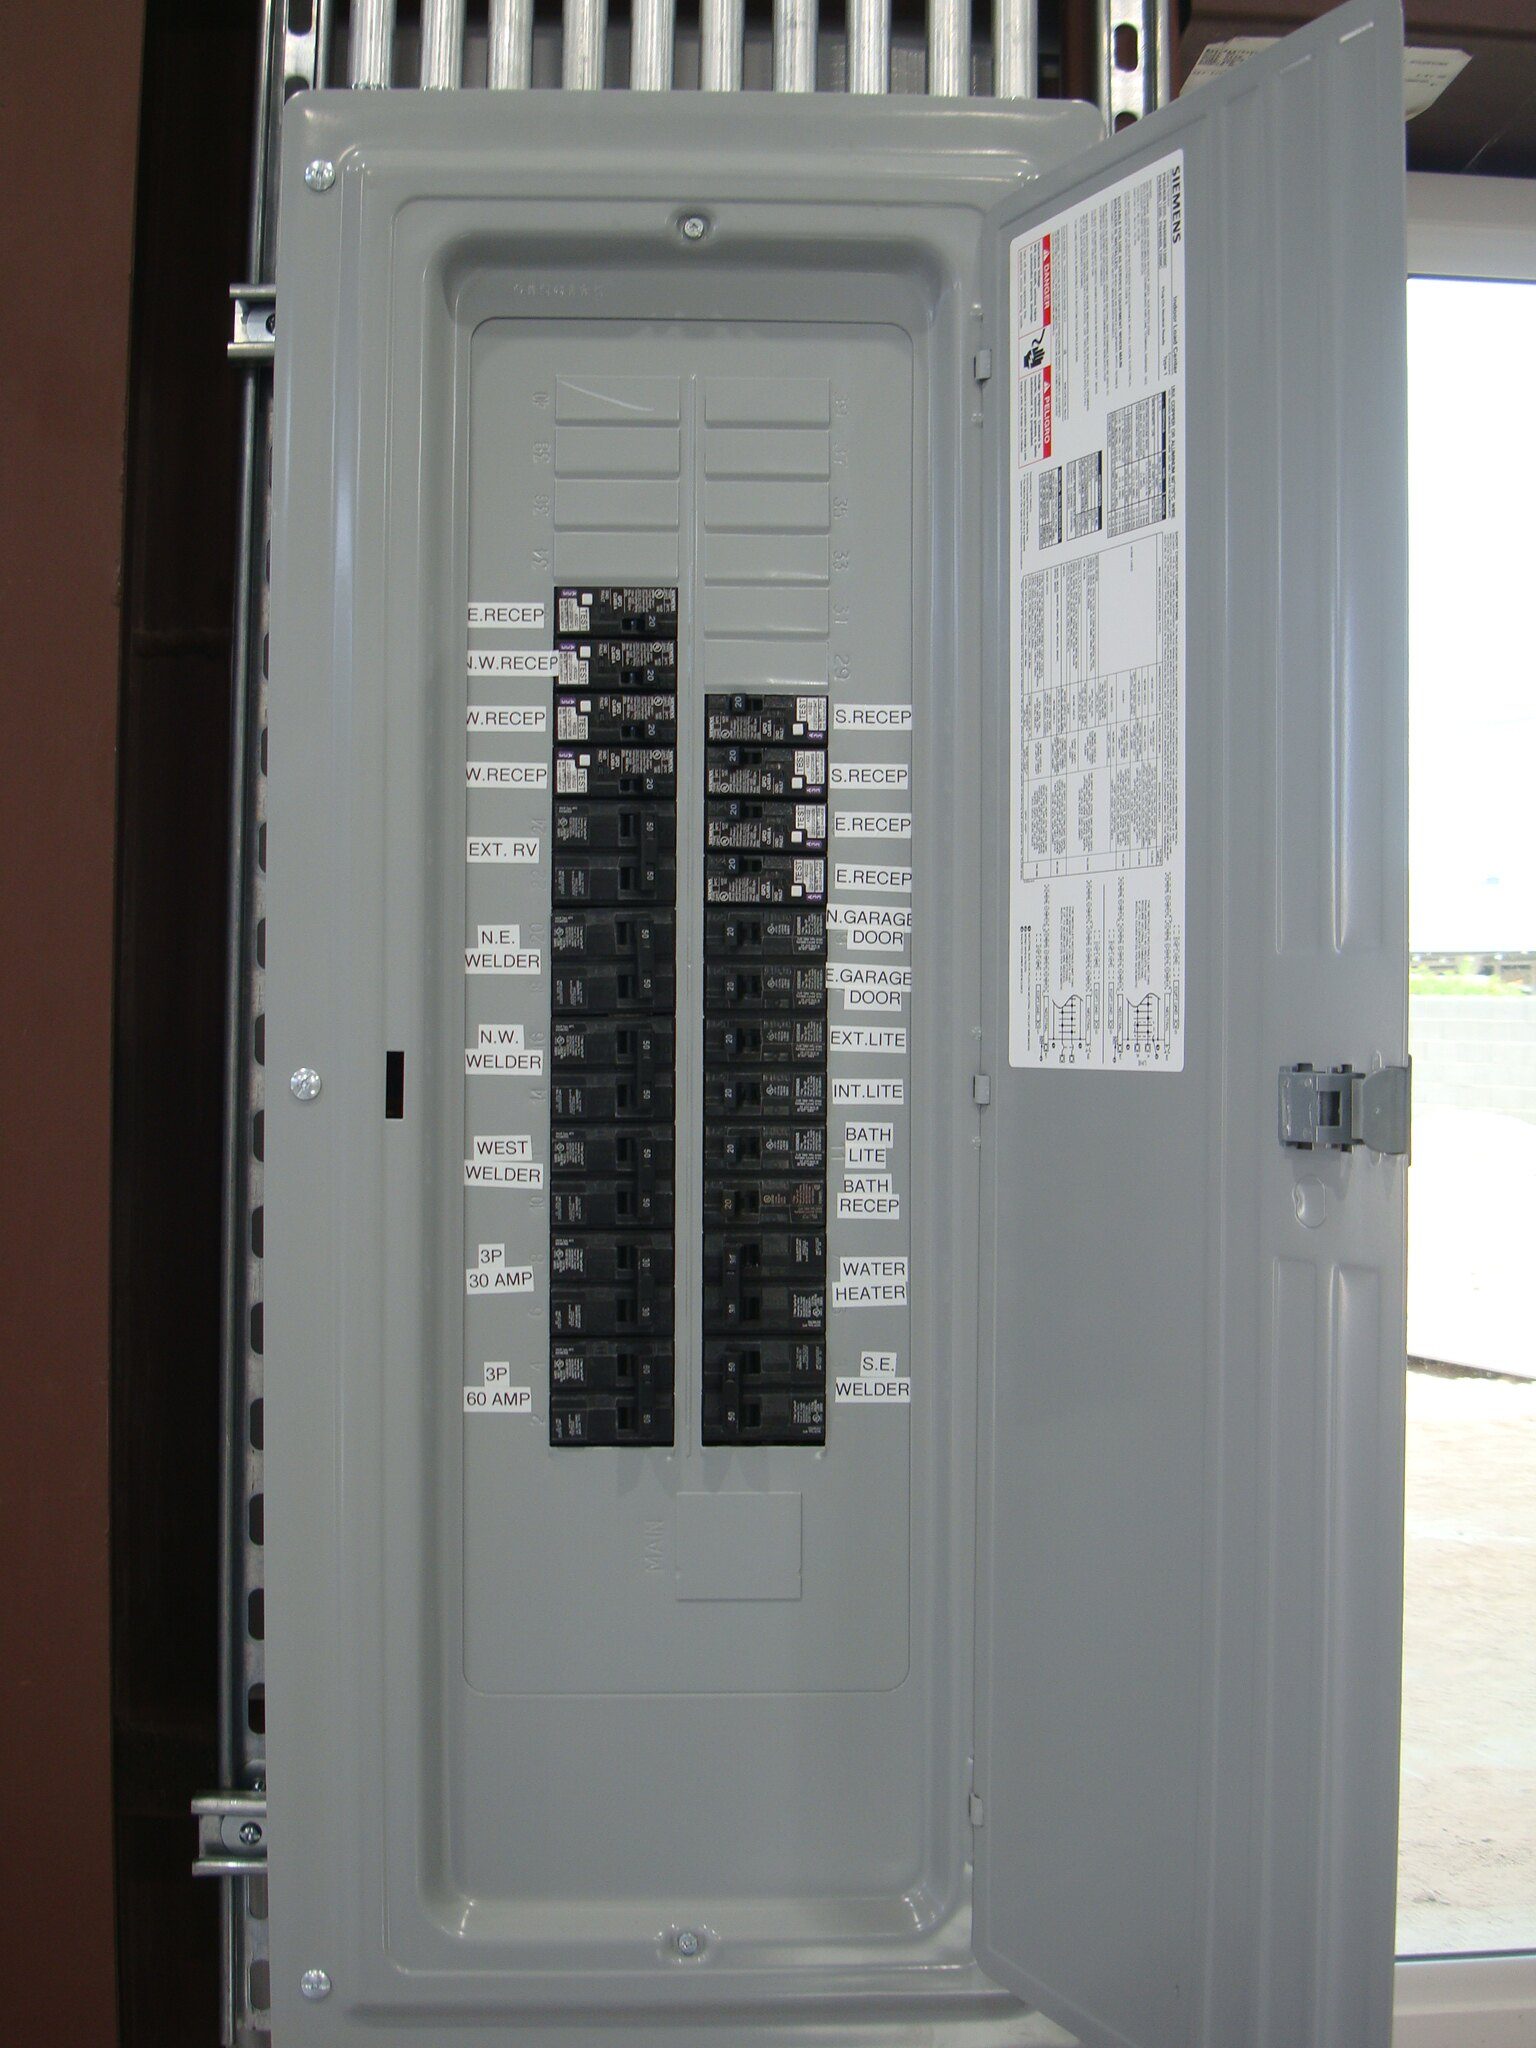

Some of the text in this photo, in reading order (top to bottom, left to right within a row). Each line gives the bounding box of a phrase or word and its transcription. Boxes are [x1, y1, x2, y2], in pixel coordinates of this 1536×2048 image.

[1171, 165, 1182, 244] SIEMENS
[1043, 264, 1051, 310] DANGER
[1043, 396, 1051, 444] PELIGRO
[468, 608, 543, 621] E.RECEP
[580, 610, 588, 630] TEST
[649, 616, 655, 627] 20
[647, 670, 654, 681] 20
[735, 697, 741, 708] 20
[467, 712, 545, 725] W.RECEP
[836, 710, 911, 723] S.RECEP
[649, 724, 655, 735] 20
[729, 750, 736, 761] 20
[466, 769, 547, 782] W.RECEP
[832, 769, 907, 782] S.RECEP
[646, 778, 653, 789] 20
[730, 804, 737, 815] 20
[836, 818, 911, 831] E.RECEP
[470, 843, 537, 856] EXT. RV
[729, 859, 735, 869] 20
[837, 870, 912, 885] E.RECEP
[482, 932, 514, 944] N.E.
[853, 930, 902, 944] DOOR
[465, 955, 539, 967] WELDER
[826, 968, 912, 985] E.GARAGE
[850, 990, 900, 1004] DOOR
[481, 1030, 518, 1043] N.W.
[831, 1031, 905, 1047] EXT.LITE
[466, 1055, 541, 1068] WELDER
[834, 1085, 902, 1098] INT.LITE
[846, 1128, 891, 1141] BATH
[477, 1141, 528, 1154] WEST
[727, 1144, 735, 1153] 20
[850, 1149, 885, 1162] LITE
[466, 1166, 540, 1182] WELDER
[844, 1180, 888, 1193] BATH
[725, 1199, 732, 1209] 20
[840, 1199, 899, 1212] RECEP
[481, 1250, 502, 1263] 3P
[843, 1263, 905, 1275] WATER
[470, 1272, 532, 1288] 30 AMP
[836, 1286, 905, 1300] HEATER
[863, 1357, 894, 1371] S.E.
[487, 1368, 507, 1381] 3P
[836, 1383, 909, 1396] WELDER
[467, 1392, 530, 1405] 60 AMP
